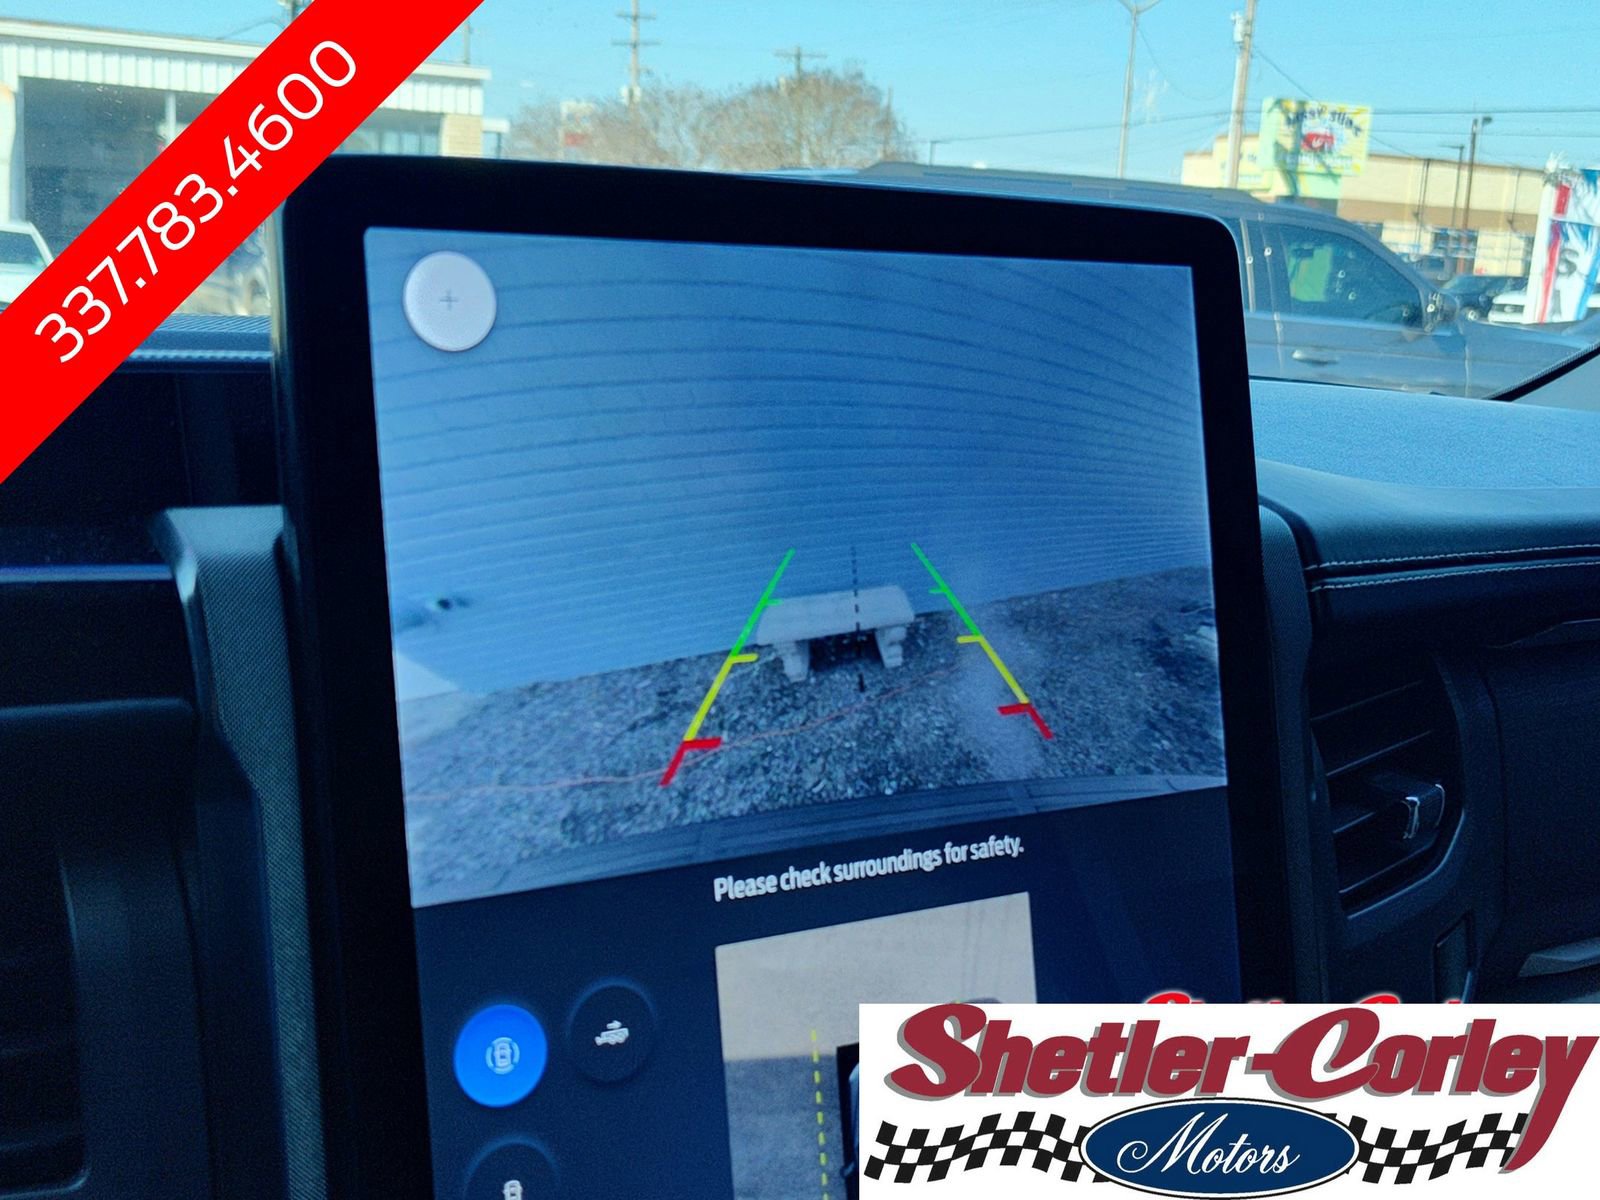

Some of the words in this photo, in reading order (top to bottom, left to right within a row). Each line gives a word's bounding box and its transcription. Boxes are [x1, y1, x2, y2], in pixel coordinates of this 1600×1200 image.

[713, 875, 778, 902] Please
[780, 861, 832, 891] check
[833, 847, 943, 883] surroundings
[943, 841, 969, 866] for
[969, 834, 1025, 861] safety.
